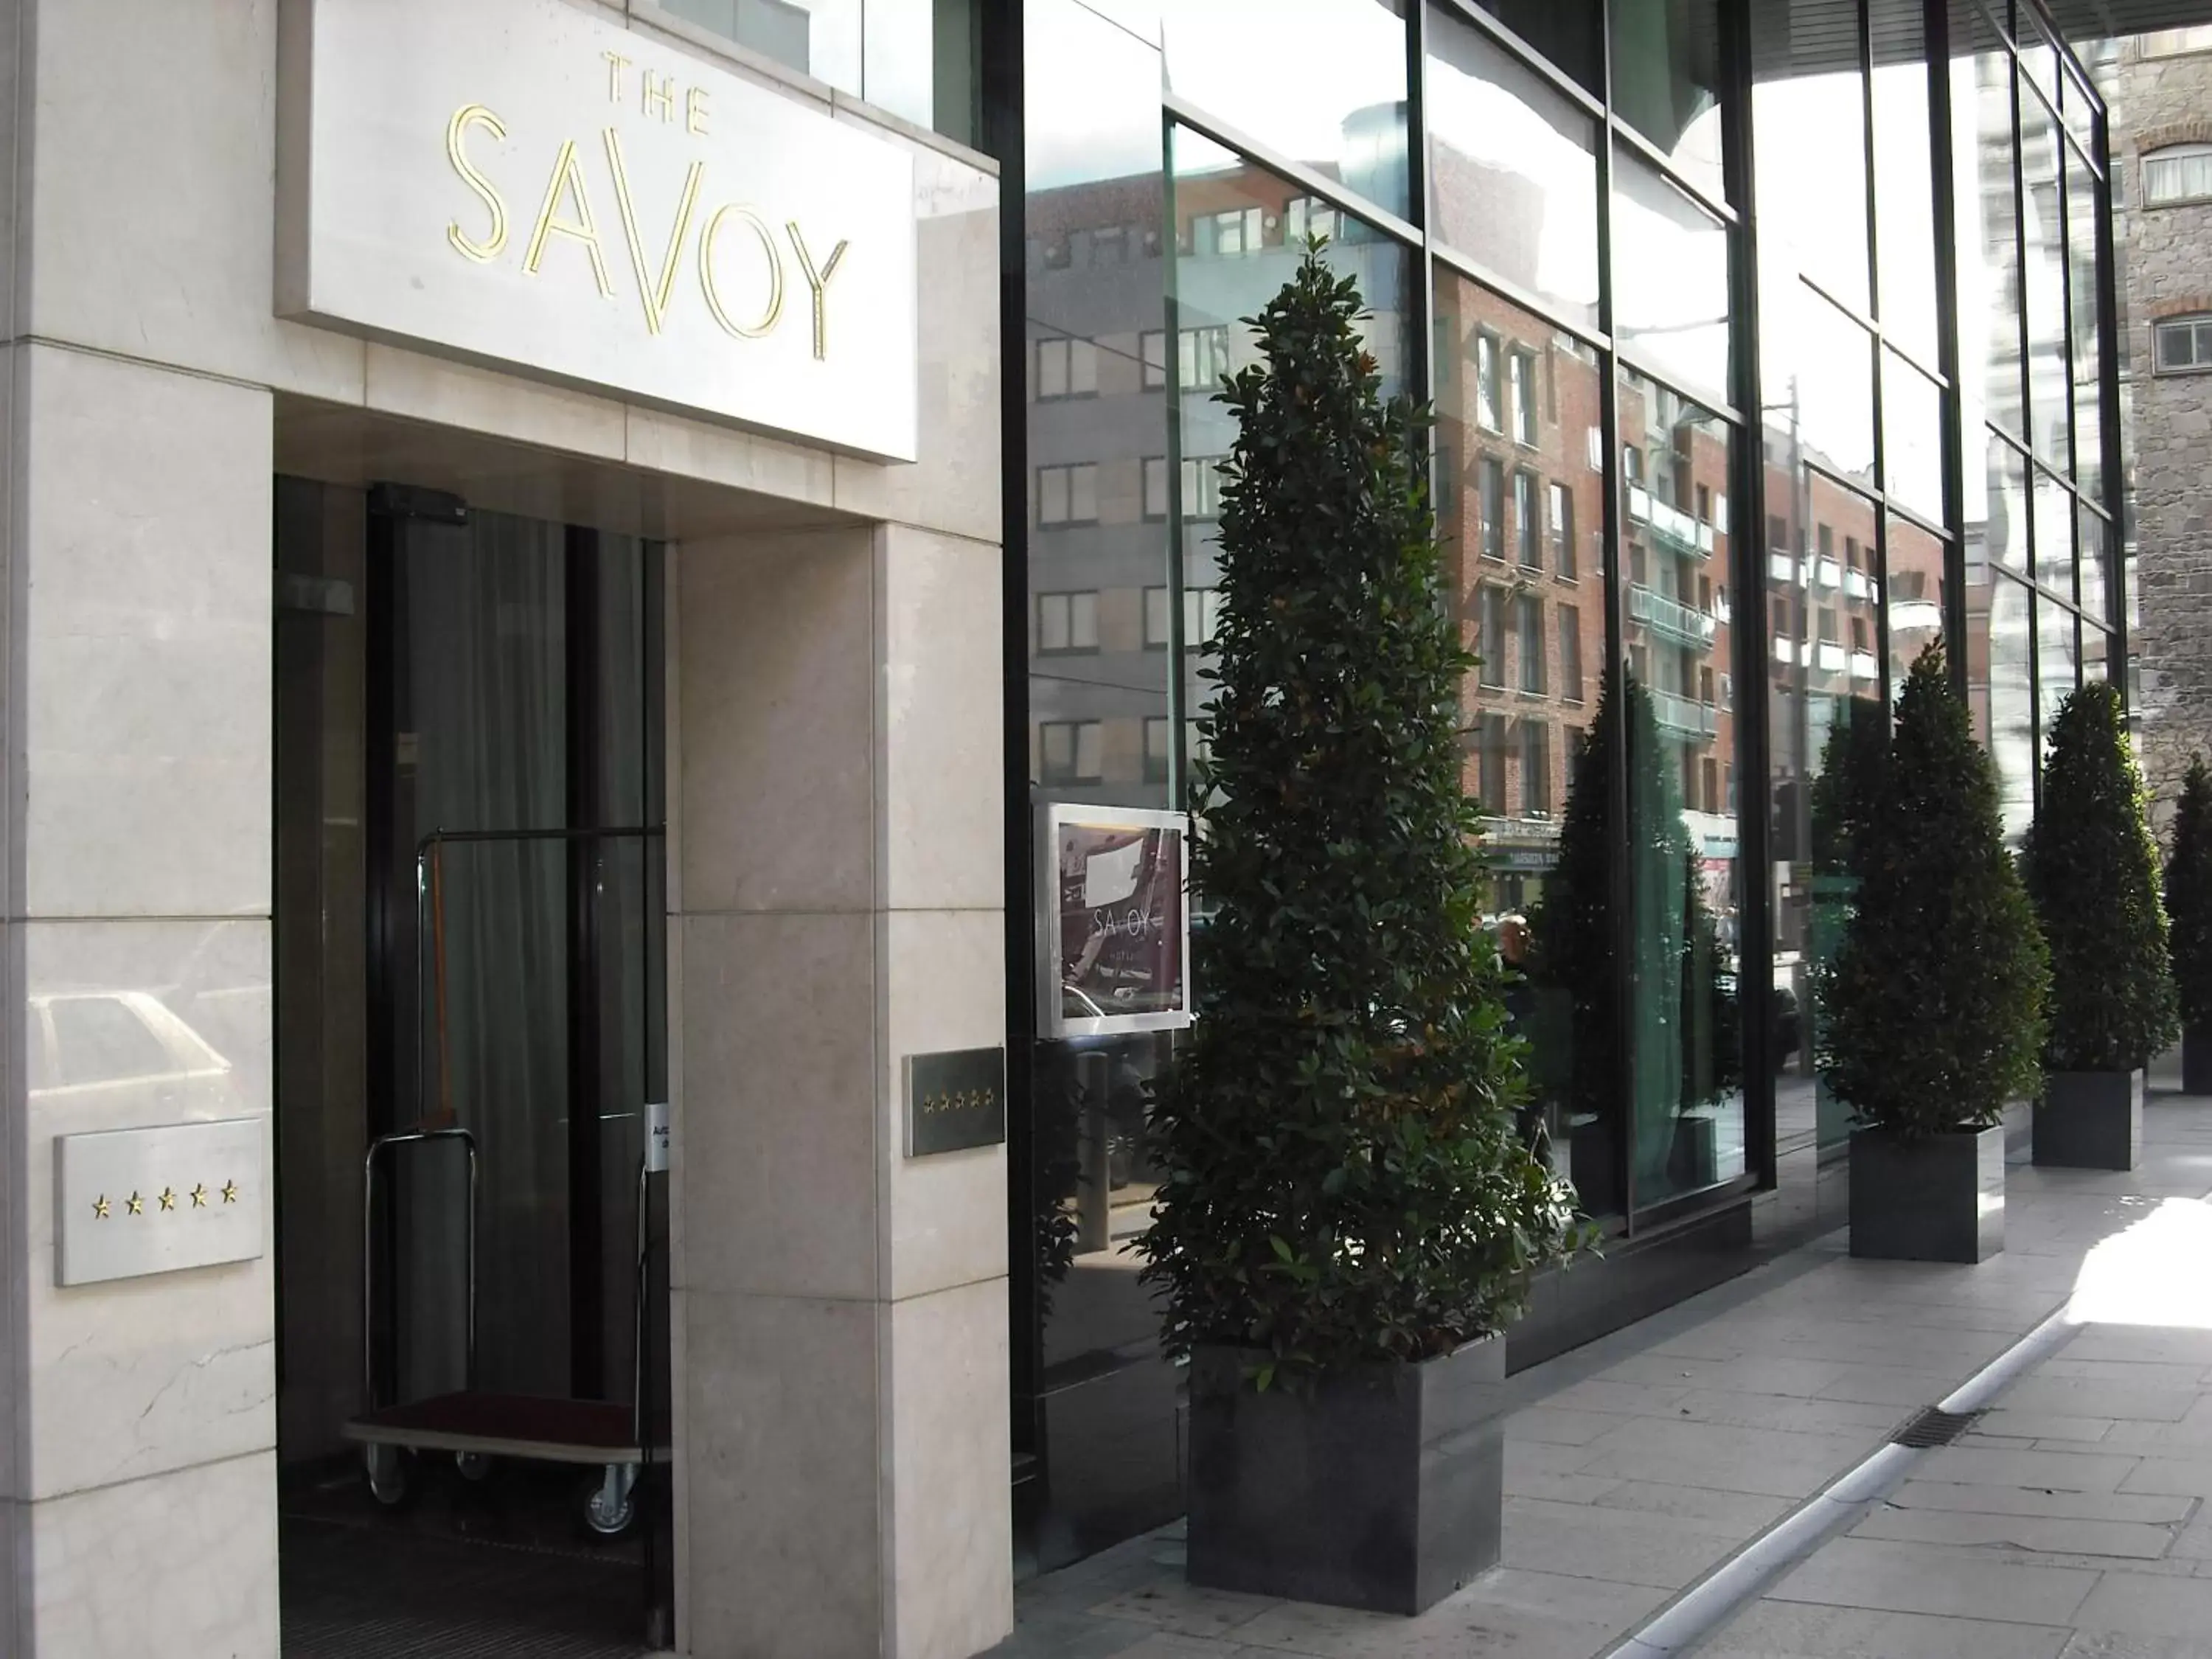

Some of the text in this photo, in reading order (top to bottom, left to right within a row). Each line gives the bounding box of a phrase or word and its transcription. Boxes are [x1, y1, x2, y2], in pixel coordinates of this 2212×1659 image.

[602, 49, 709, 136] THE
[446, 102, 851, 362] SAVOY
[1094, 908, 1150, 936] SAOY
